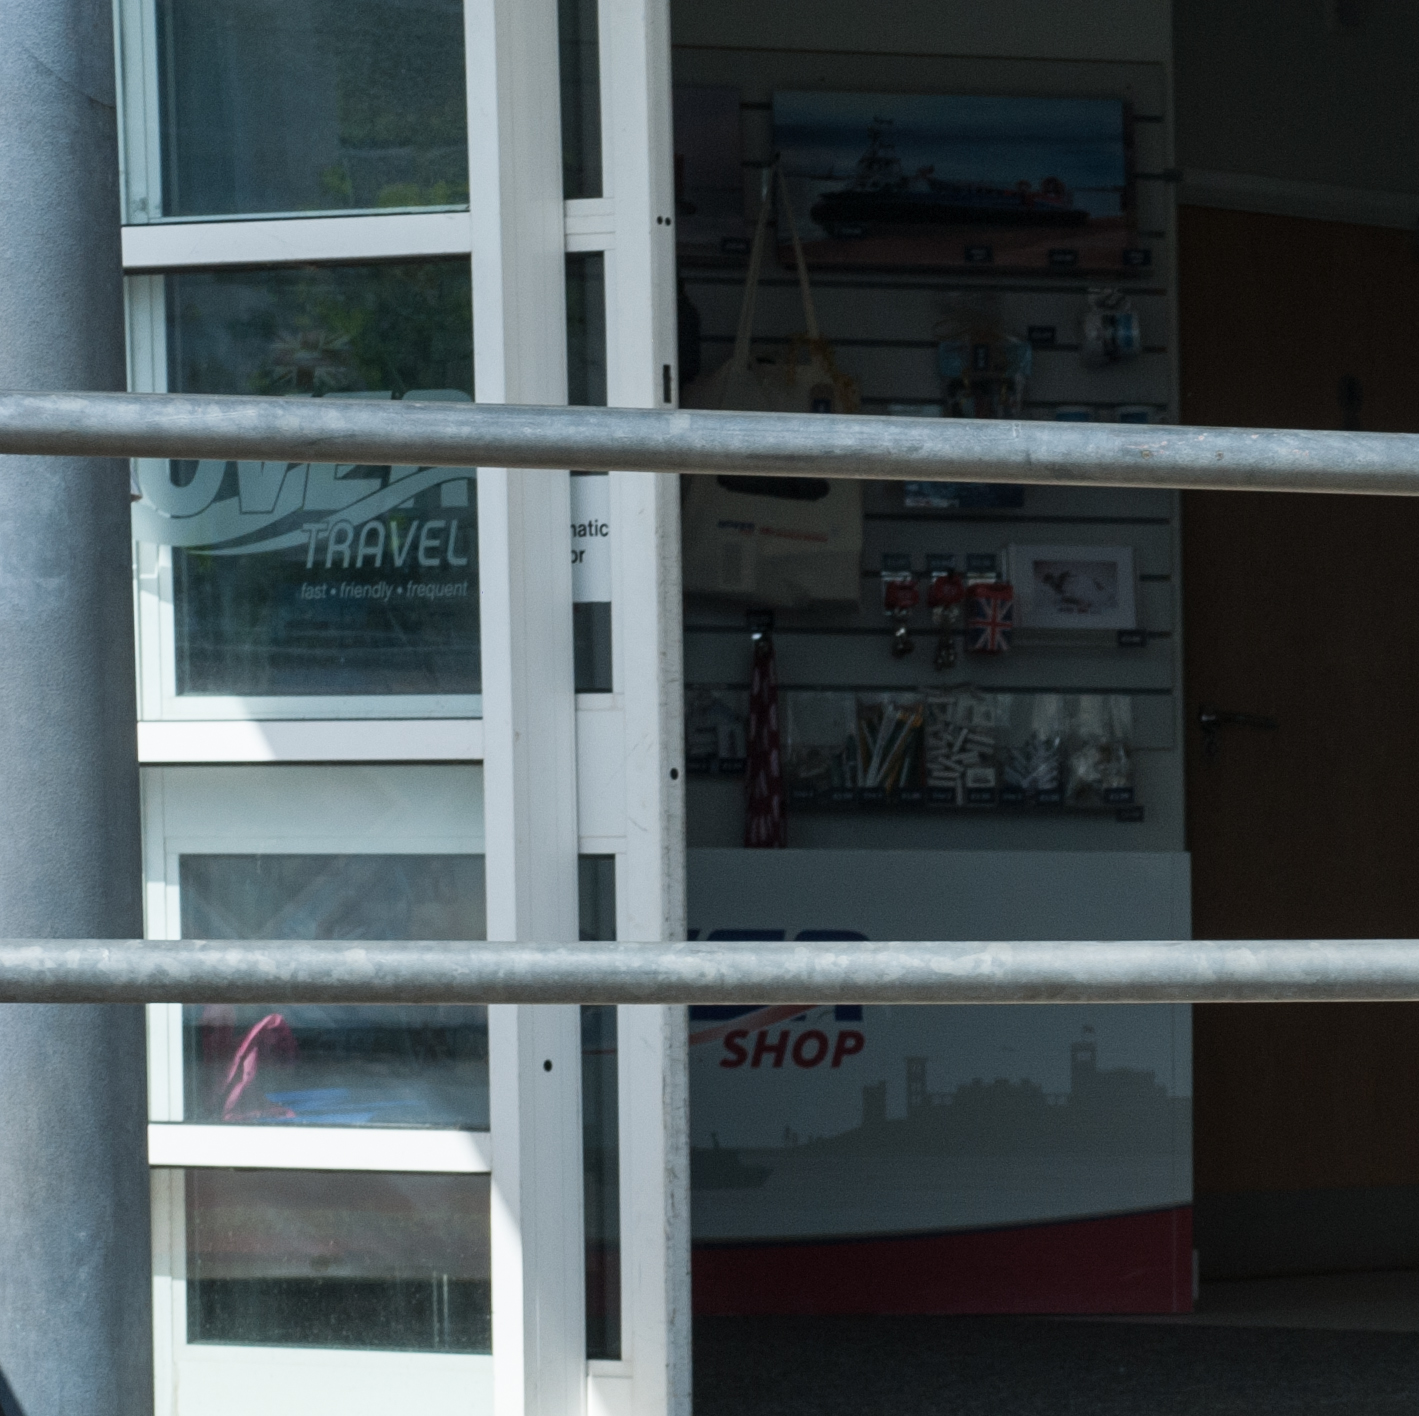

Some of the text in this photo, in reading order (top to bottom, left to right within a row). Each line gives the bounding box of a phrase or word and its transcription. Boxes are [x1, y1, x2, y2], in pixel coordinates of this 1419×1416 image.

[302, 520, 468, 569] TRAVEL
[302, 580, 468, 601] fast friendly frequent
[719, 1029, 866, 1069] SHOP
